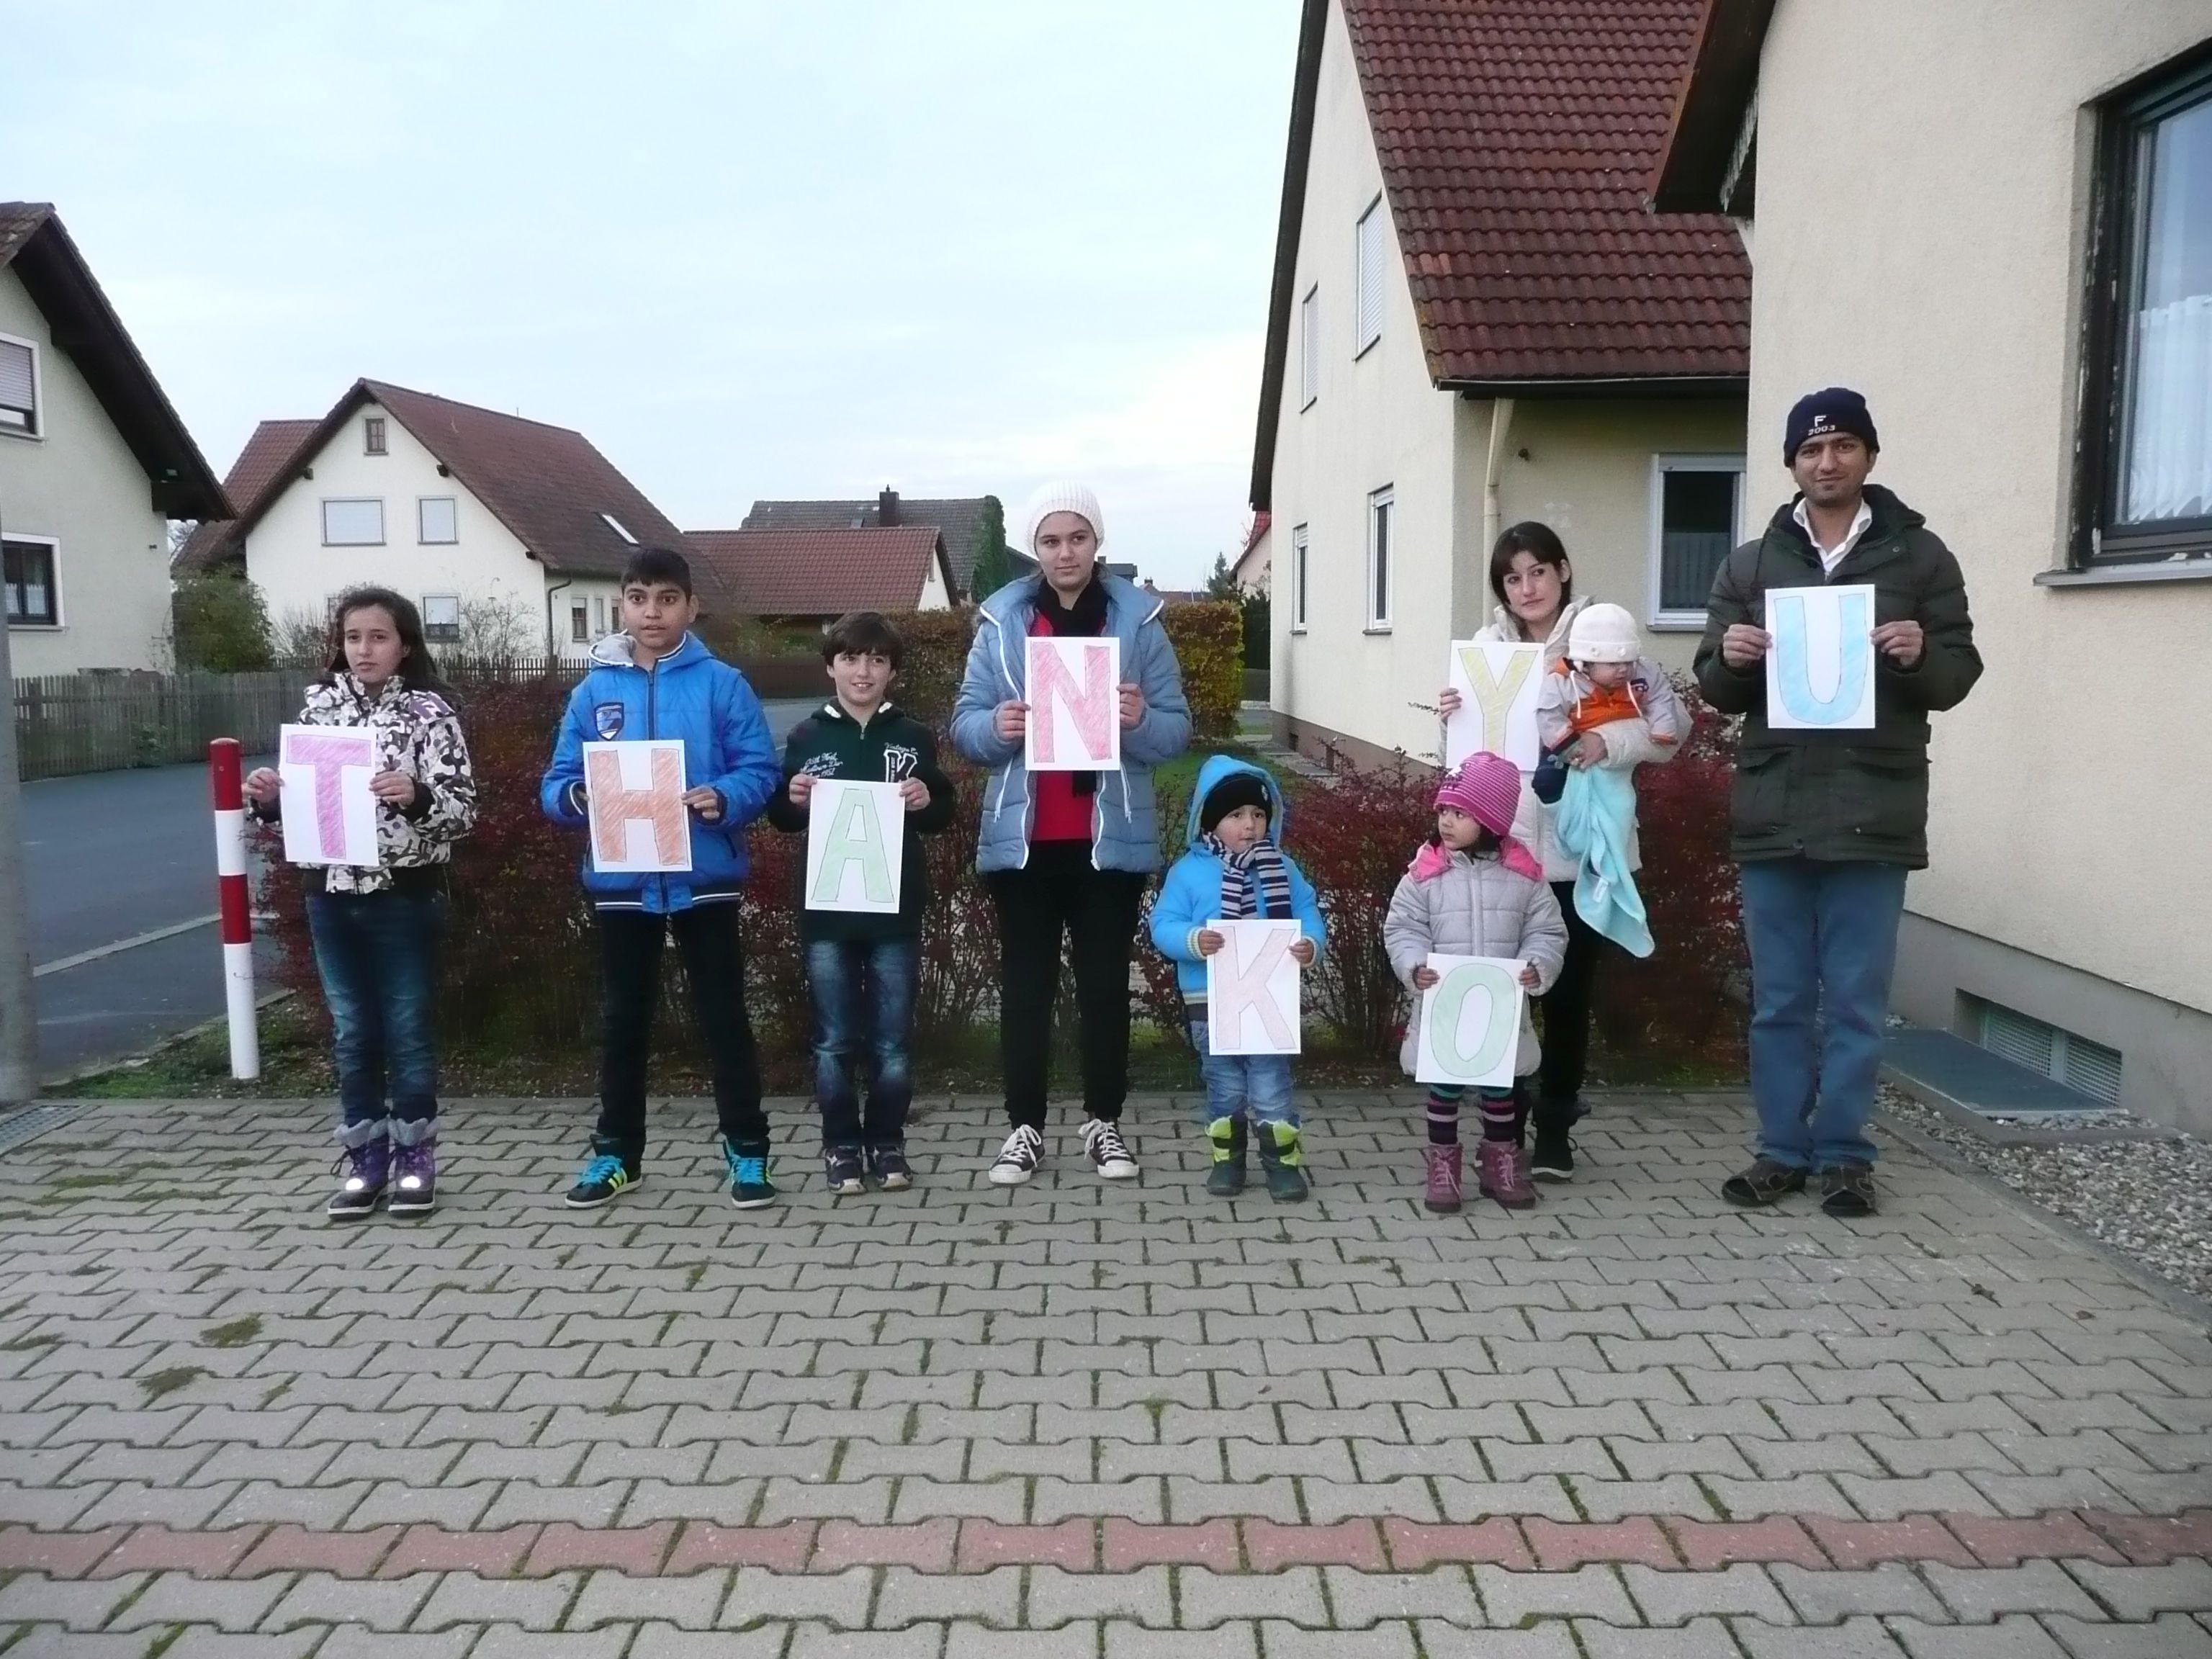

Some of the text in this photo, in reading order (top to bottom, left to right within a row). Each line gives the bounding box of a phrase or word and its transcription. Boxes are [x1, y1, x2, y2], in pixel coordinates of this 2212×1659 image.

[1807, 424, 1836, 436] 2003
[1814, 415, 1827, 427] F
[1030, 641, 1112, 763] N
[1457, 647, 1539, 756] Y
[1774, 593, 1868, 726] U
[286, 734, 372, 860] T
[588, 748, 689, 866] H
[811, 788, 895, 903] A
[1214, 927, 1297, 1051] K
[1429, 963, 1516, 1078] O
